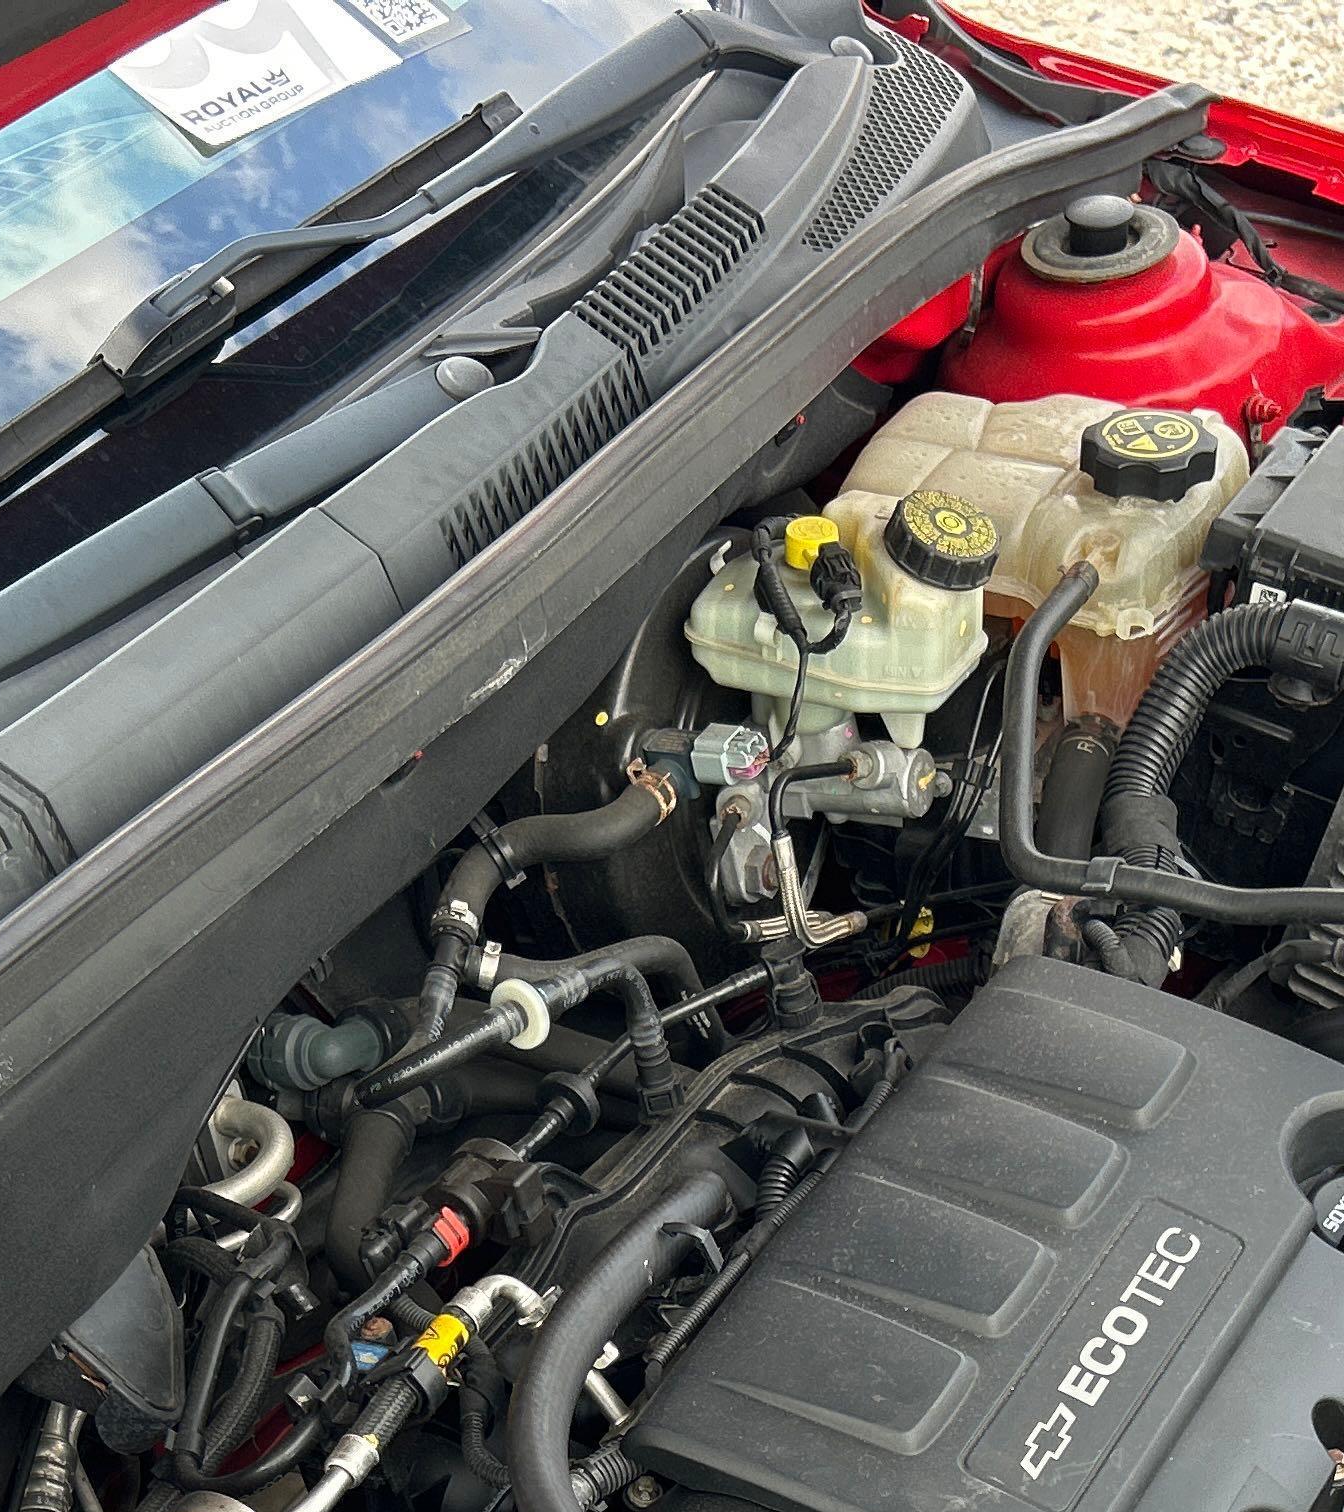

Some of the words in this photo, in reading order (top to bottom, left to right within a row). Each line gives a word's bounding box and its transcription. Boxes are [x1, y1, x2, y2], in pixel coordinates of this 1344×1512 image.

[180, 81, 273, 126] ROYAL
[203, 104, 262, 134] AUCTION
[259, 84, 304, 110] GROUP
[1057, 1227, 1201, 1407] ECOTEC
